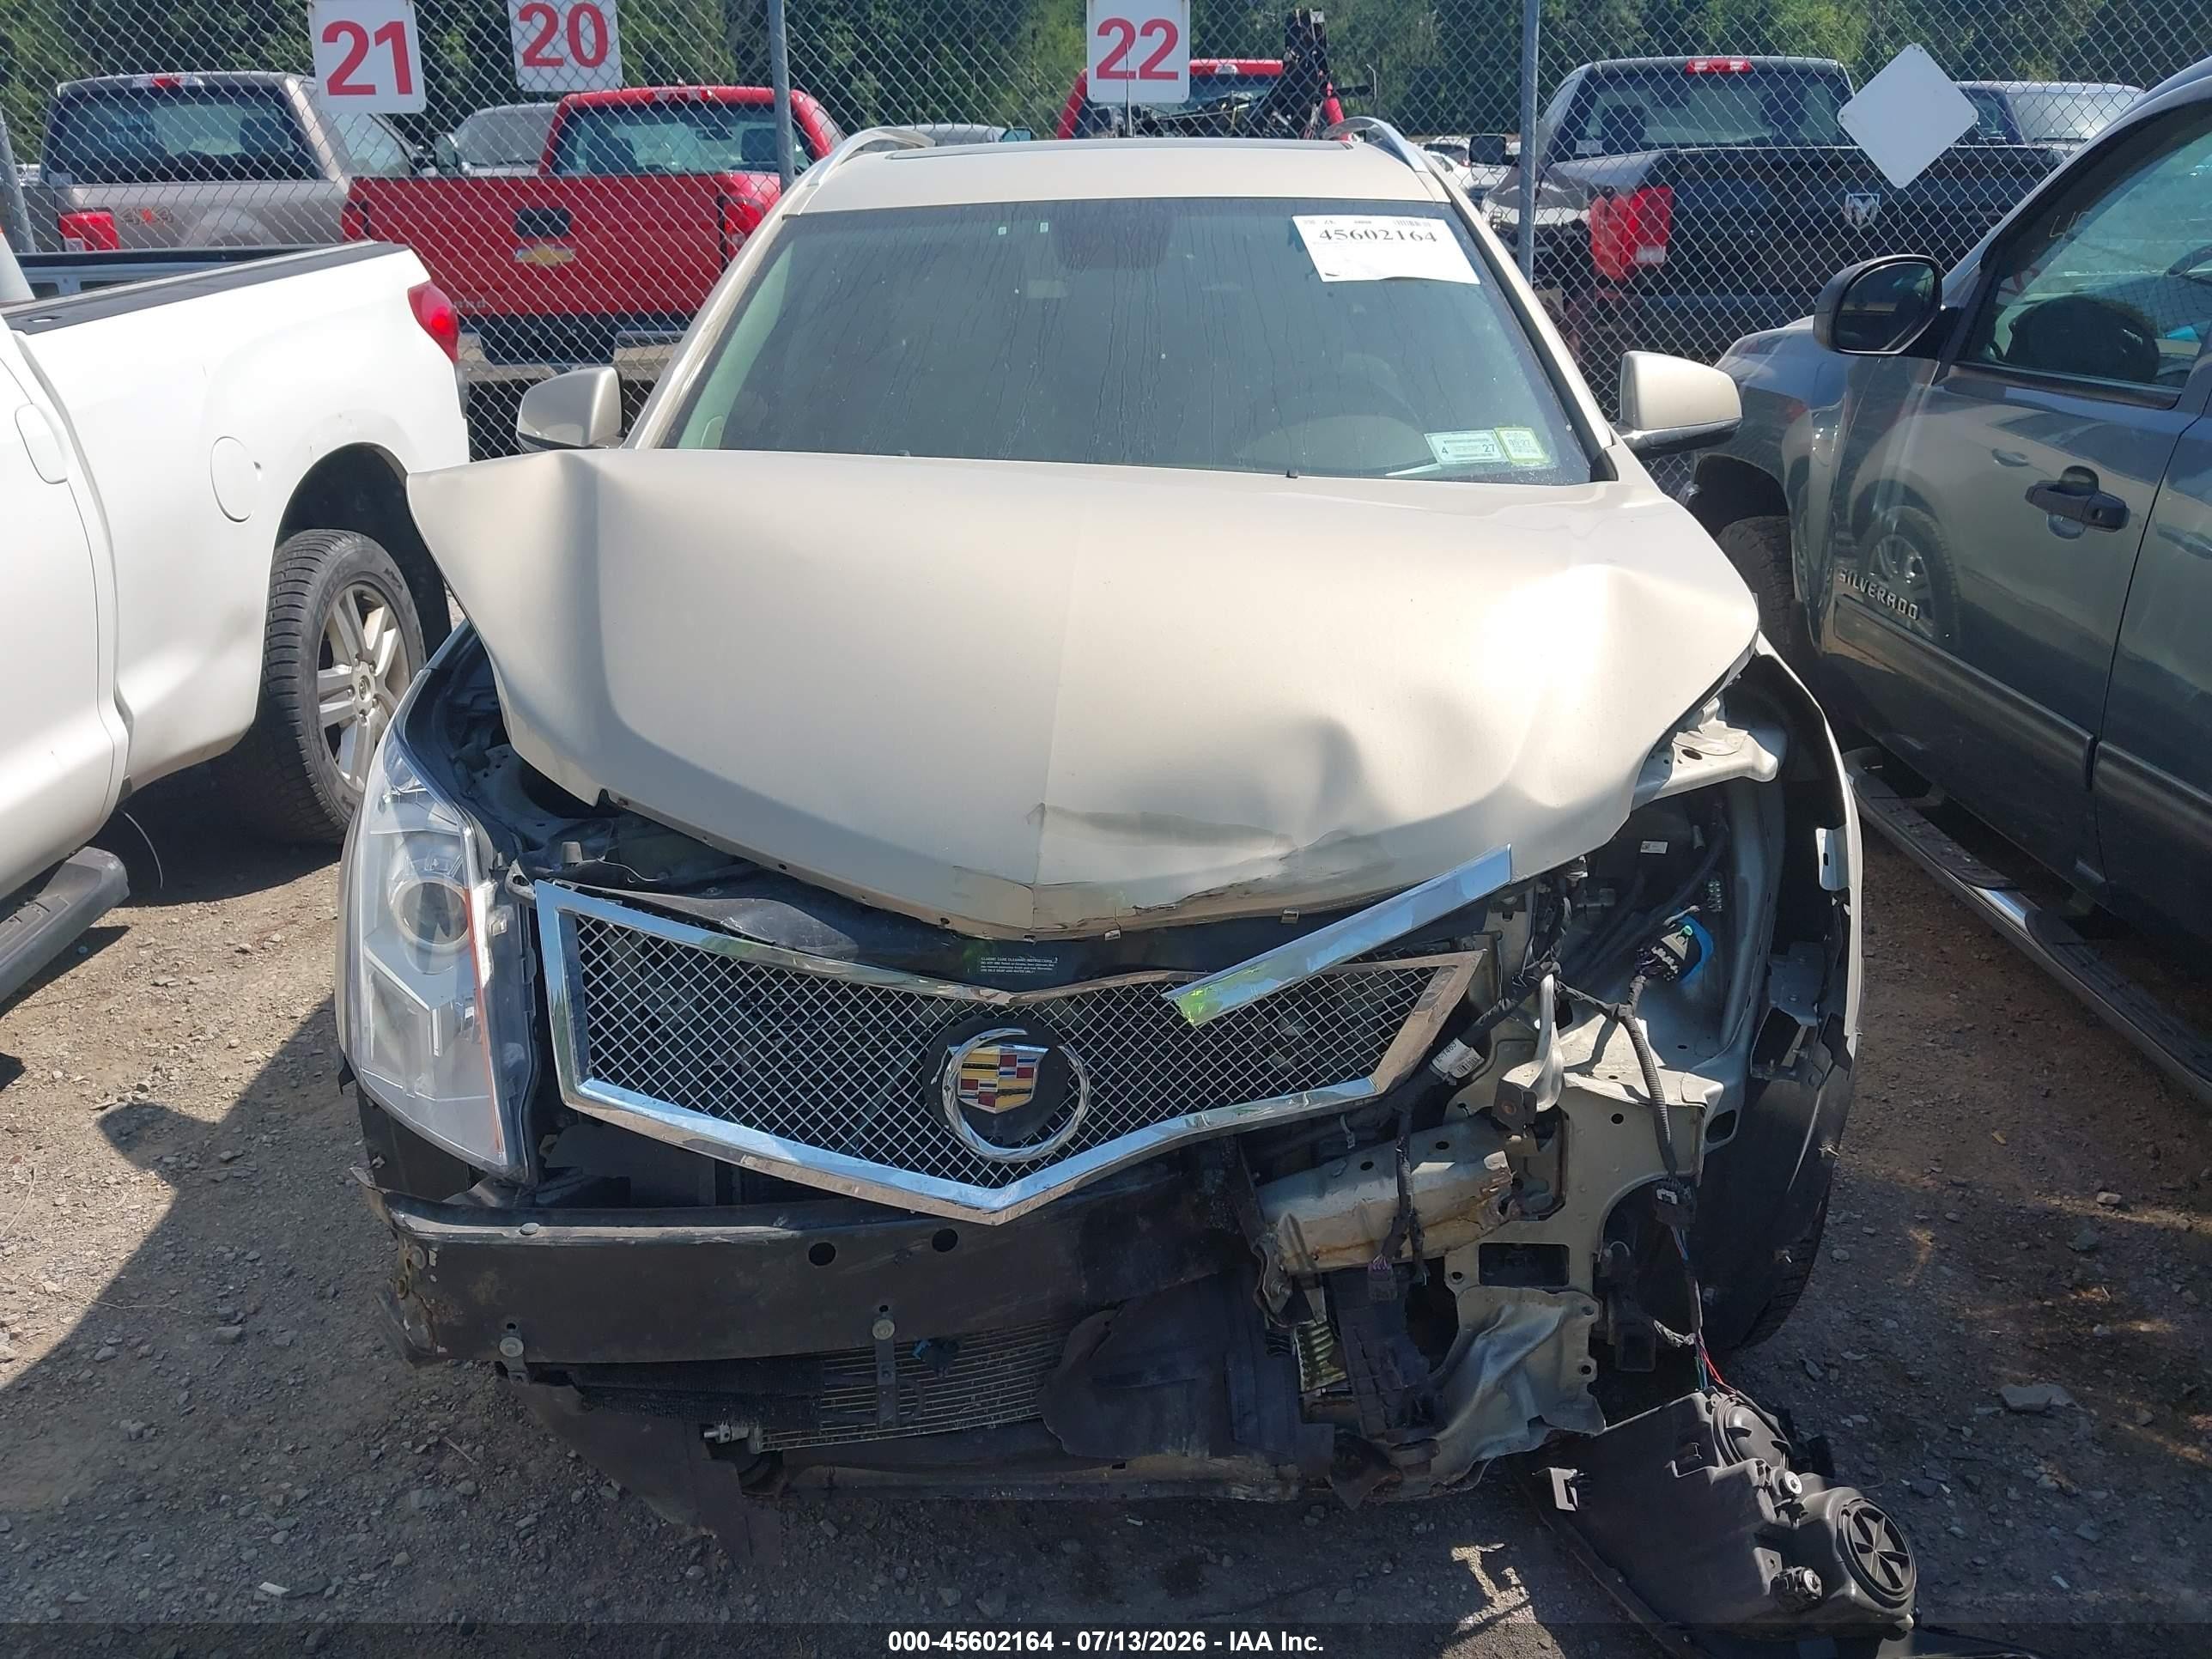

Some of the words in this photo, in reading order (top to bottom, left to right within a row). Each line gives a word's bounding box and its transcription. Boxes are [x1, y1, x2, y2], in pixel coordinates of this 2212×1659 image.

[321, 21, 413, 96] 21
[518, 3, 609, 68] 20
[1096, 17, 1179, 81] 22
[1319, 228, 1438, 242] 45602164
[1482, 444, 1496, 453] 27
[1839, 568, 1919, 620] SILVERADO
